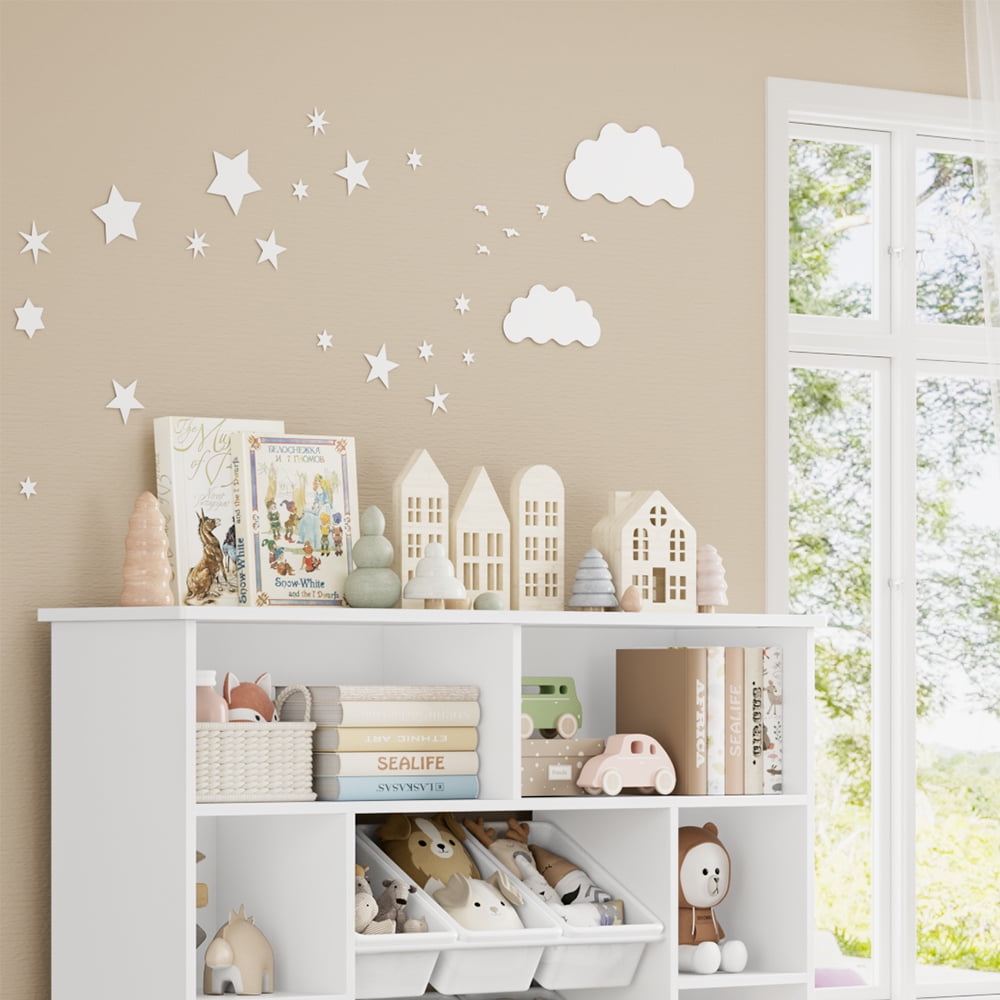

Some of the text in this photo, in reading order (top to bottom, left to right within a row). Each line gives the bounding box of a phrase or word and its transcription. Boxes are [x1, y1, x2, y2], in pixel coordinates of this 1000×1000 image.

[274, 576, 326, 589] Snow-White
[730, 684, 742, 757] SEALIFE
[364, 735, 391, 744] ART
[377, 756, 445, 771] SEALIFE
[376, 783, 434, 792] LASKASAS
